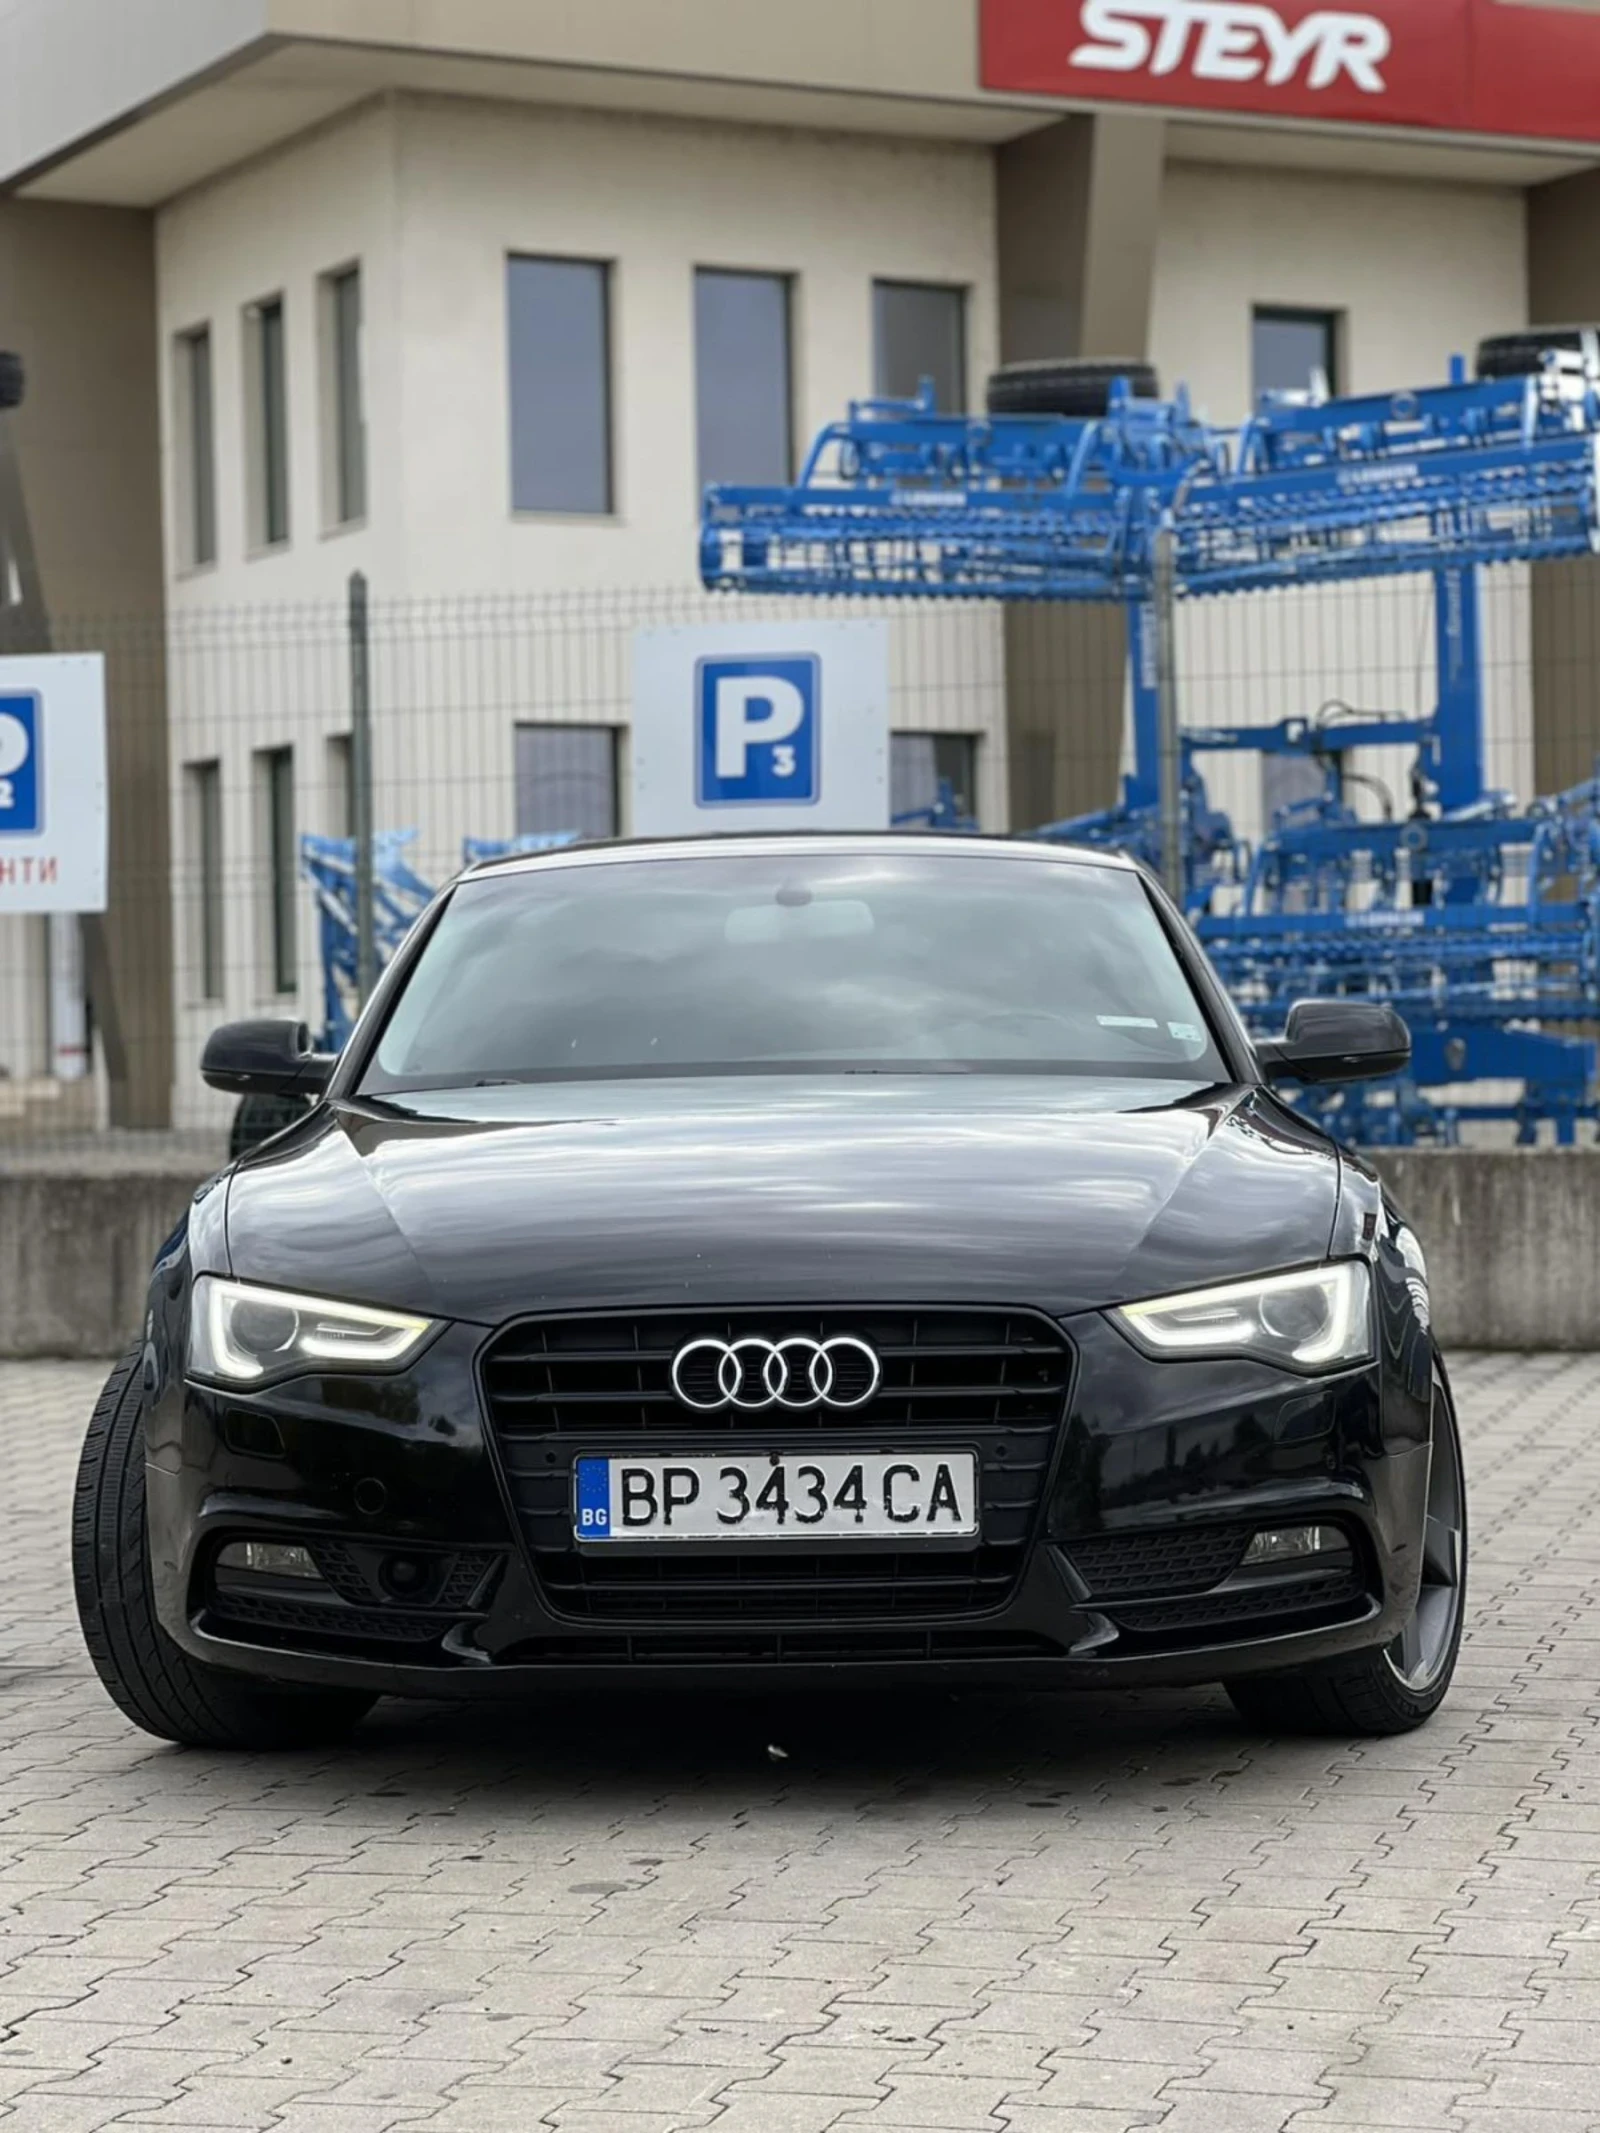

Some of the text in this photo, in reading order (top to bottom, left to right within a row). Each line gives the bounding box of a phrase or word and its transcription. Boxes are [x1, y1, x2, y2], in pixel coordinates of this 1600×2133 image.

[1068, 0, 1390, 93] STEYR
[581, 1508, 607, 1526] BG
[620, 1463, 962, 1527] BP 3434 CA
